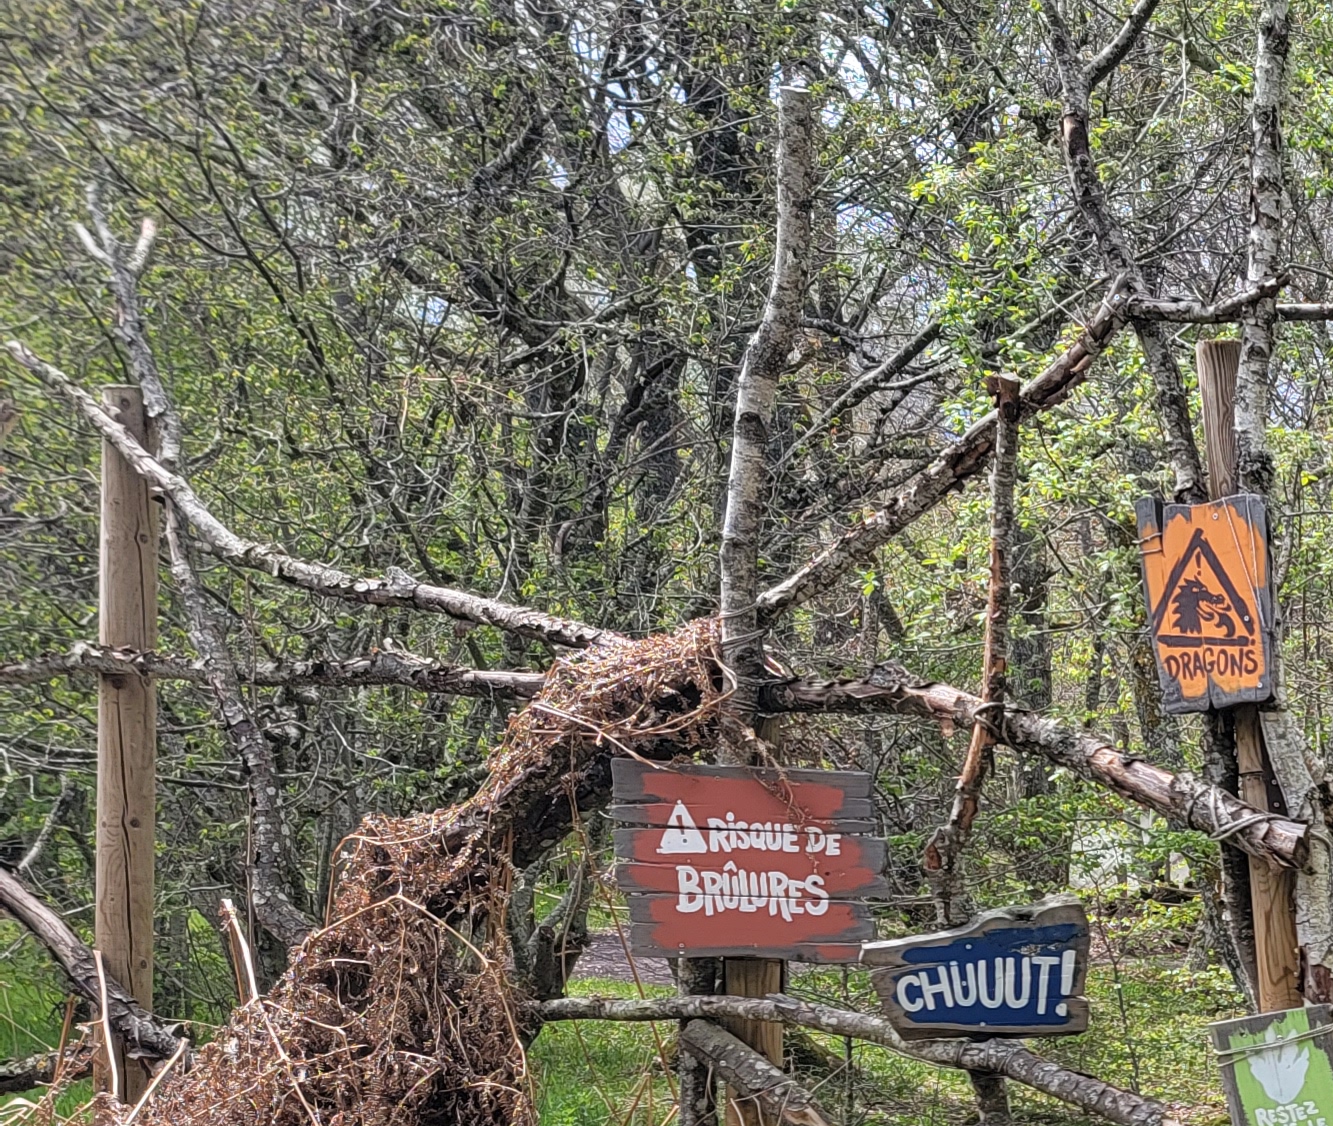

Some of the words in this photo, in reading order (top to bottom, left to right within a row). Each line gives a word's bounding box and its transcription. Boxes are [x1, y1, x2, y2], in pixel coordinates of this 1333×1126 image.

[1164, 647, 1258, 683] DRAGONS
[805, 826, 842, 856] DE
[675, 860, 830, 923] BRÛLURES
[896, 950, 1077, 1017] CHUUUT!
